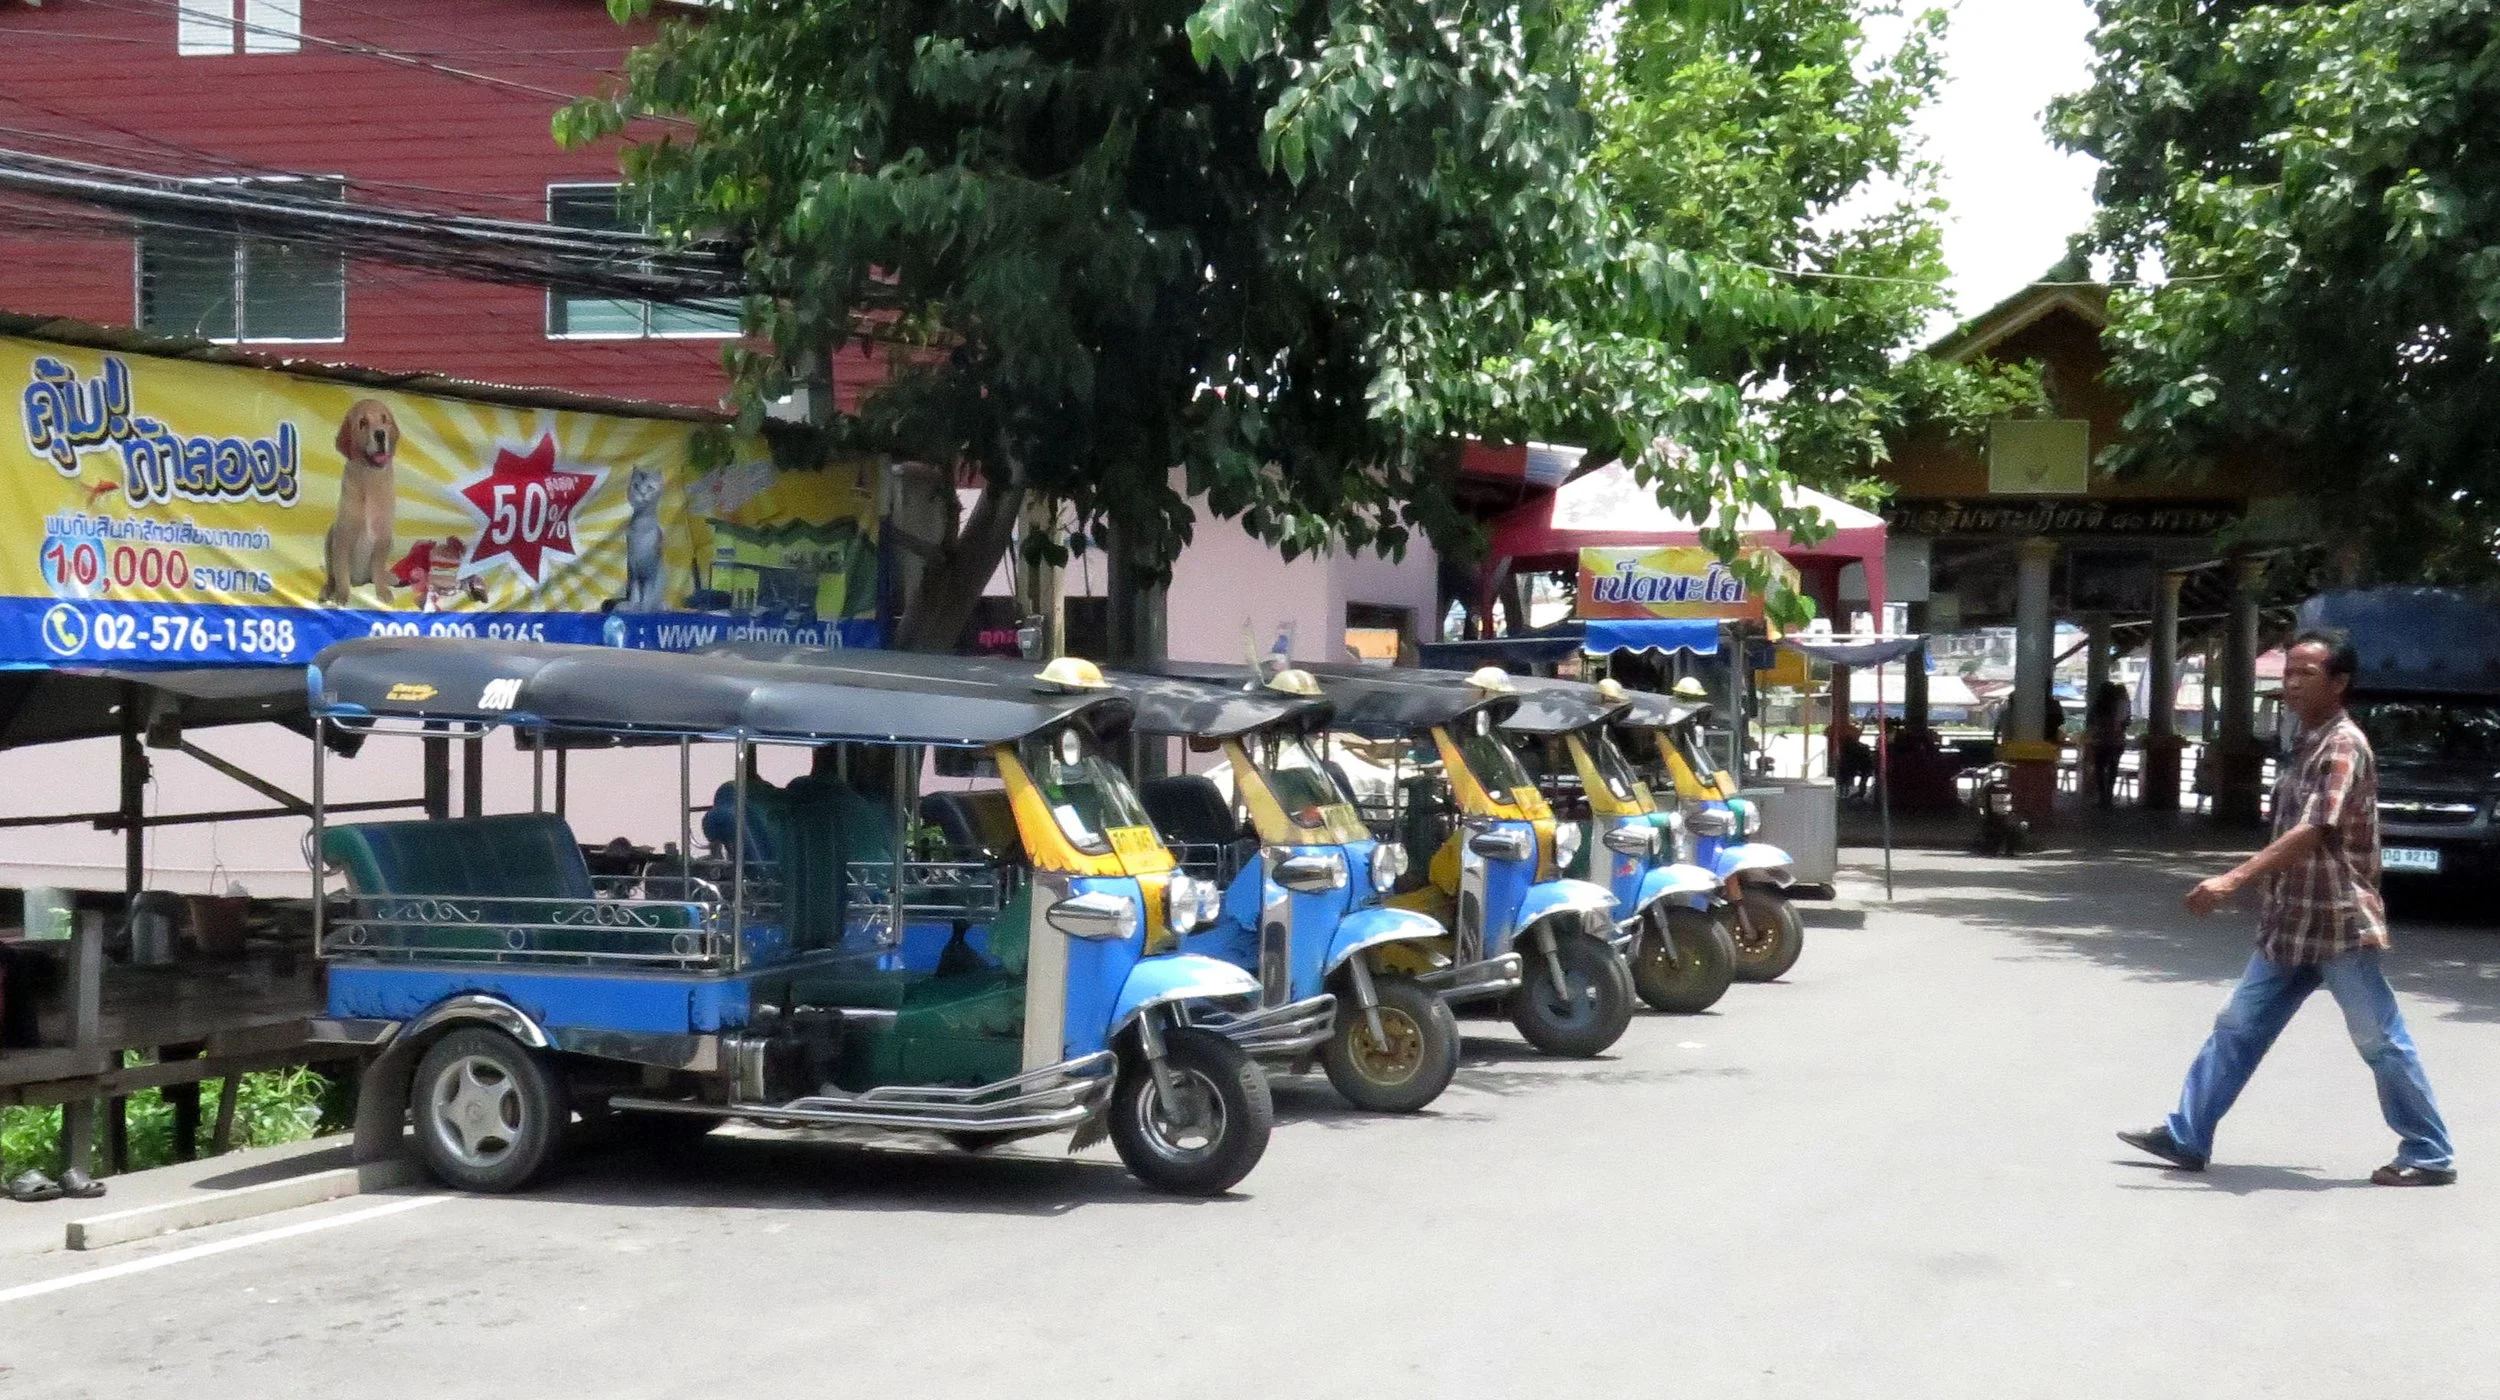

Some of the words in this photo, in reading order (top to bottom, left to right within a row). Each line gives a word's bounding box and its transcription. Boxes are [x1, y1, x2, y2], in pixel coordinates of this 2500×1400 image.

[24, 356, 131, 474] คุ้ม!
[493, 484, 568, 543] 50%
[47, 544, 189, 592] 10,000
[194, 567, 272, 593] รายการ
[1591, 558, 1746, 603] เป็ดพะโล
[94, 614, 296, 654] 02-576-1588
[657, 621, 843, 649] wwwpetprocoth
